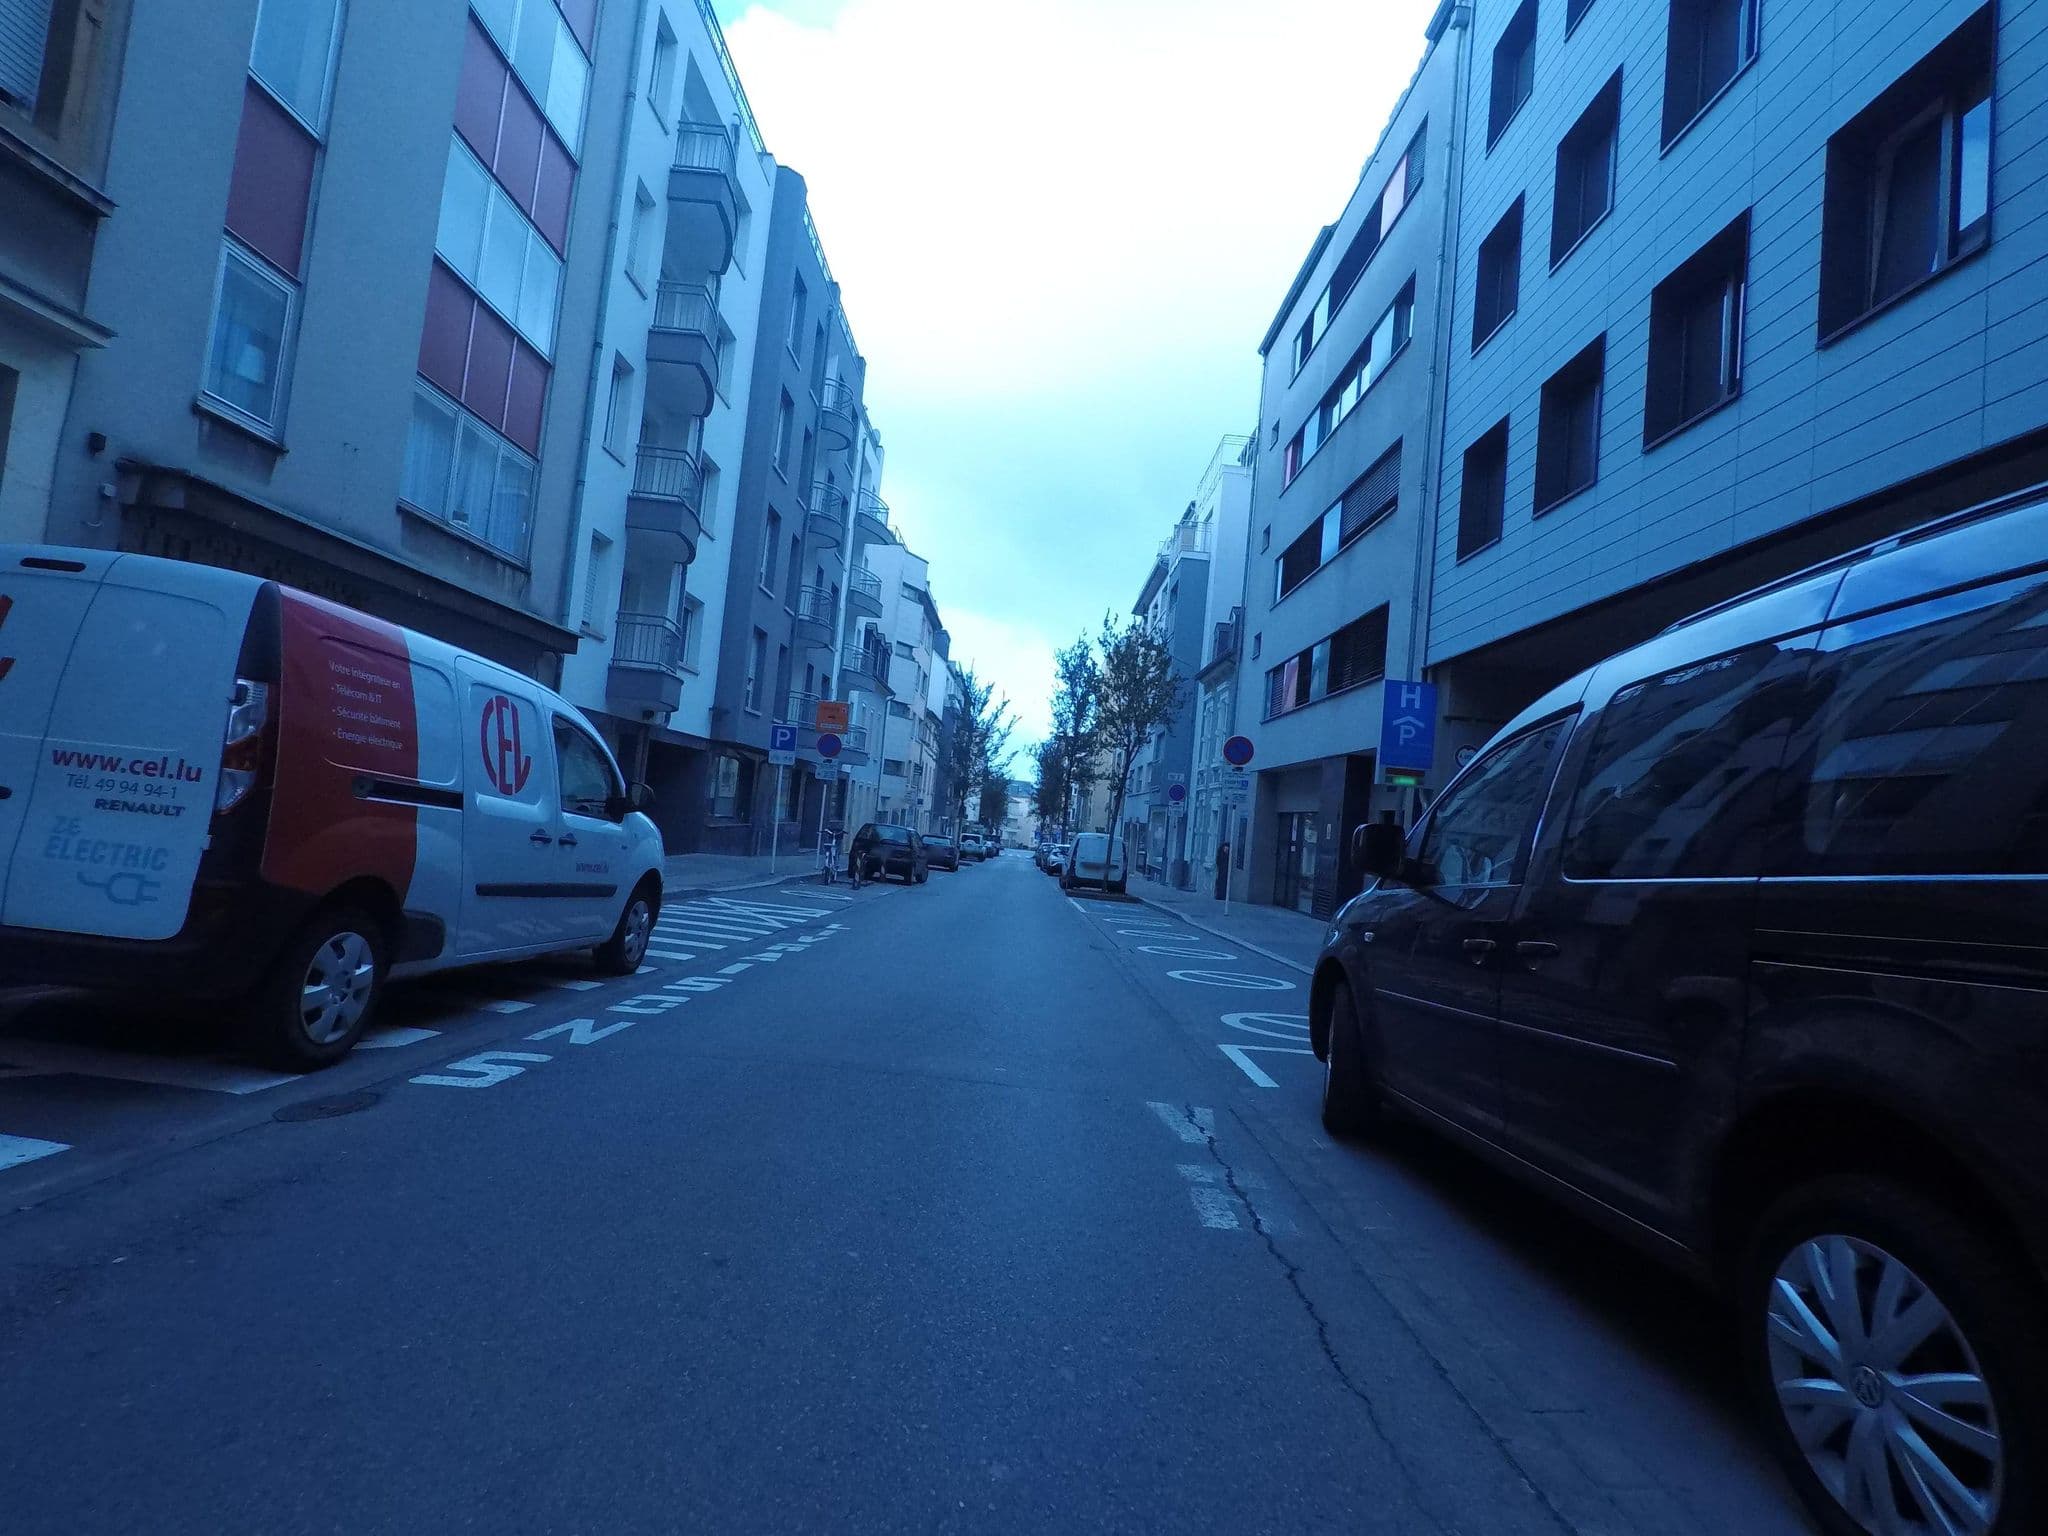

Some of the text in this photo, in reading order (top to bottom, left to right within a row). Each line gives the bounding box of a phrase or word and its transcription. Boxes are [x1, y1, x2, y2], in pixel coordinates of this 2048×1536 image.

[1400, 684, 1421, 709] H
[776, 728, 791, 748] P
[1399, 725, 1416, 746] P
[52, 749, 203, 783] www.cel.lu
[66, 773, 177, 799] Tél. 49 94 94-1
[93, 798, 186, 817] RENAULT
[44, 835, 169, 872] ELECTRIC
